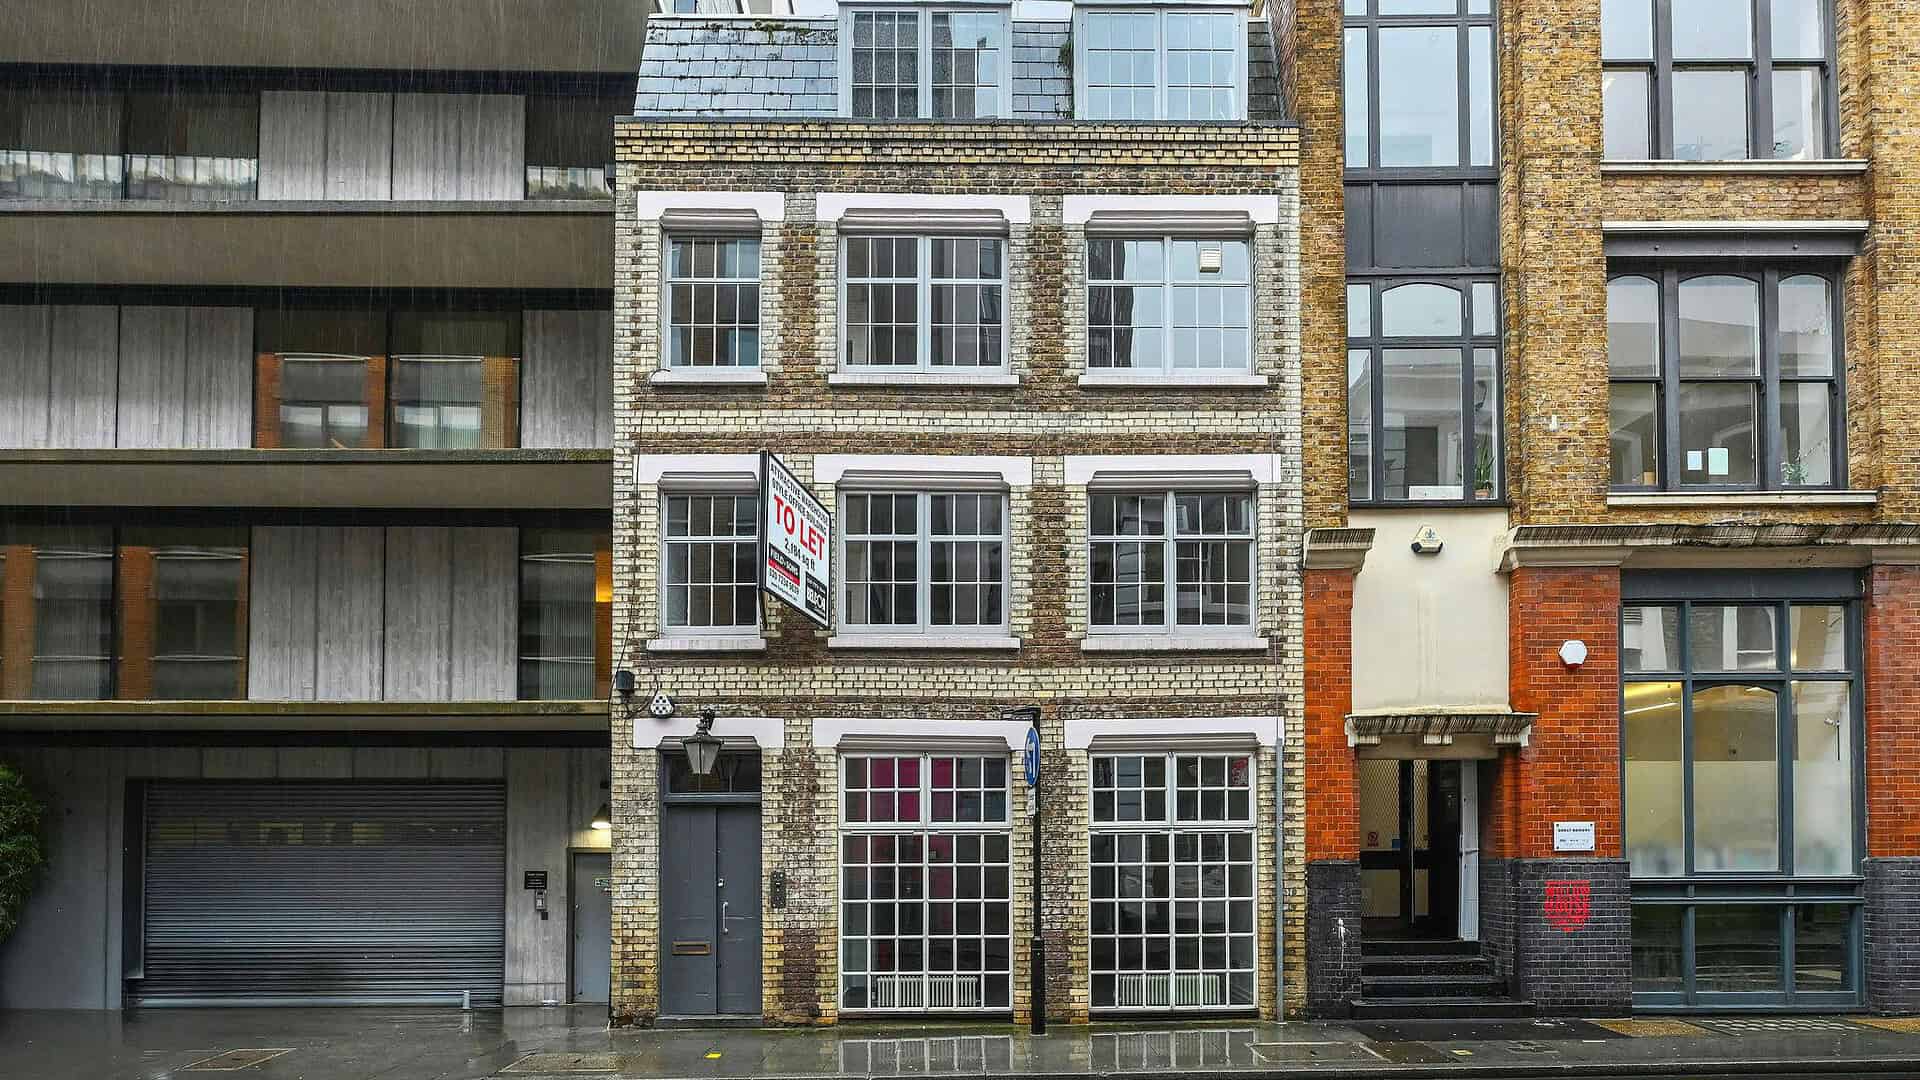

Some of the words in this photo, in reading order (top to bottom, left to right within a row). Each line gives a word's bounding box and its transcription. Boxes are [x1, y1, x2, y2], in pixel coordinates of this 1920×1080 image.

[771, 463, 801, 499] ATTRACTIVE
[801, 492, 829, 527] WAREHOUSE
[772, 477, 788, 501] STYLE
[788, 494, 806, 517] OFFICE
[773, 494, 796, 536] TO
[800, 517, 826, 561] LET
